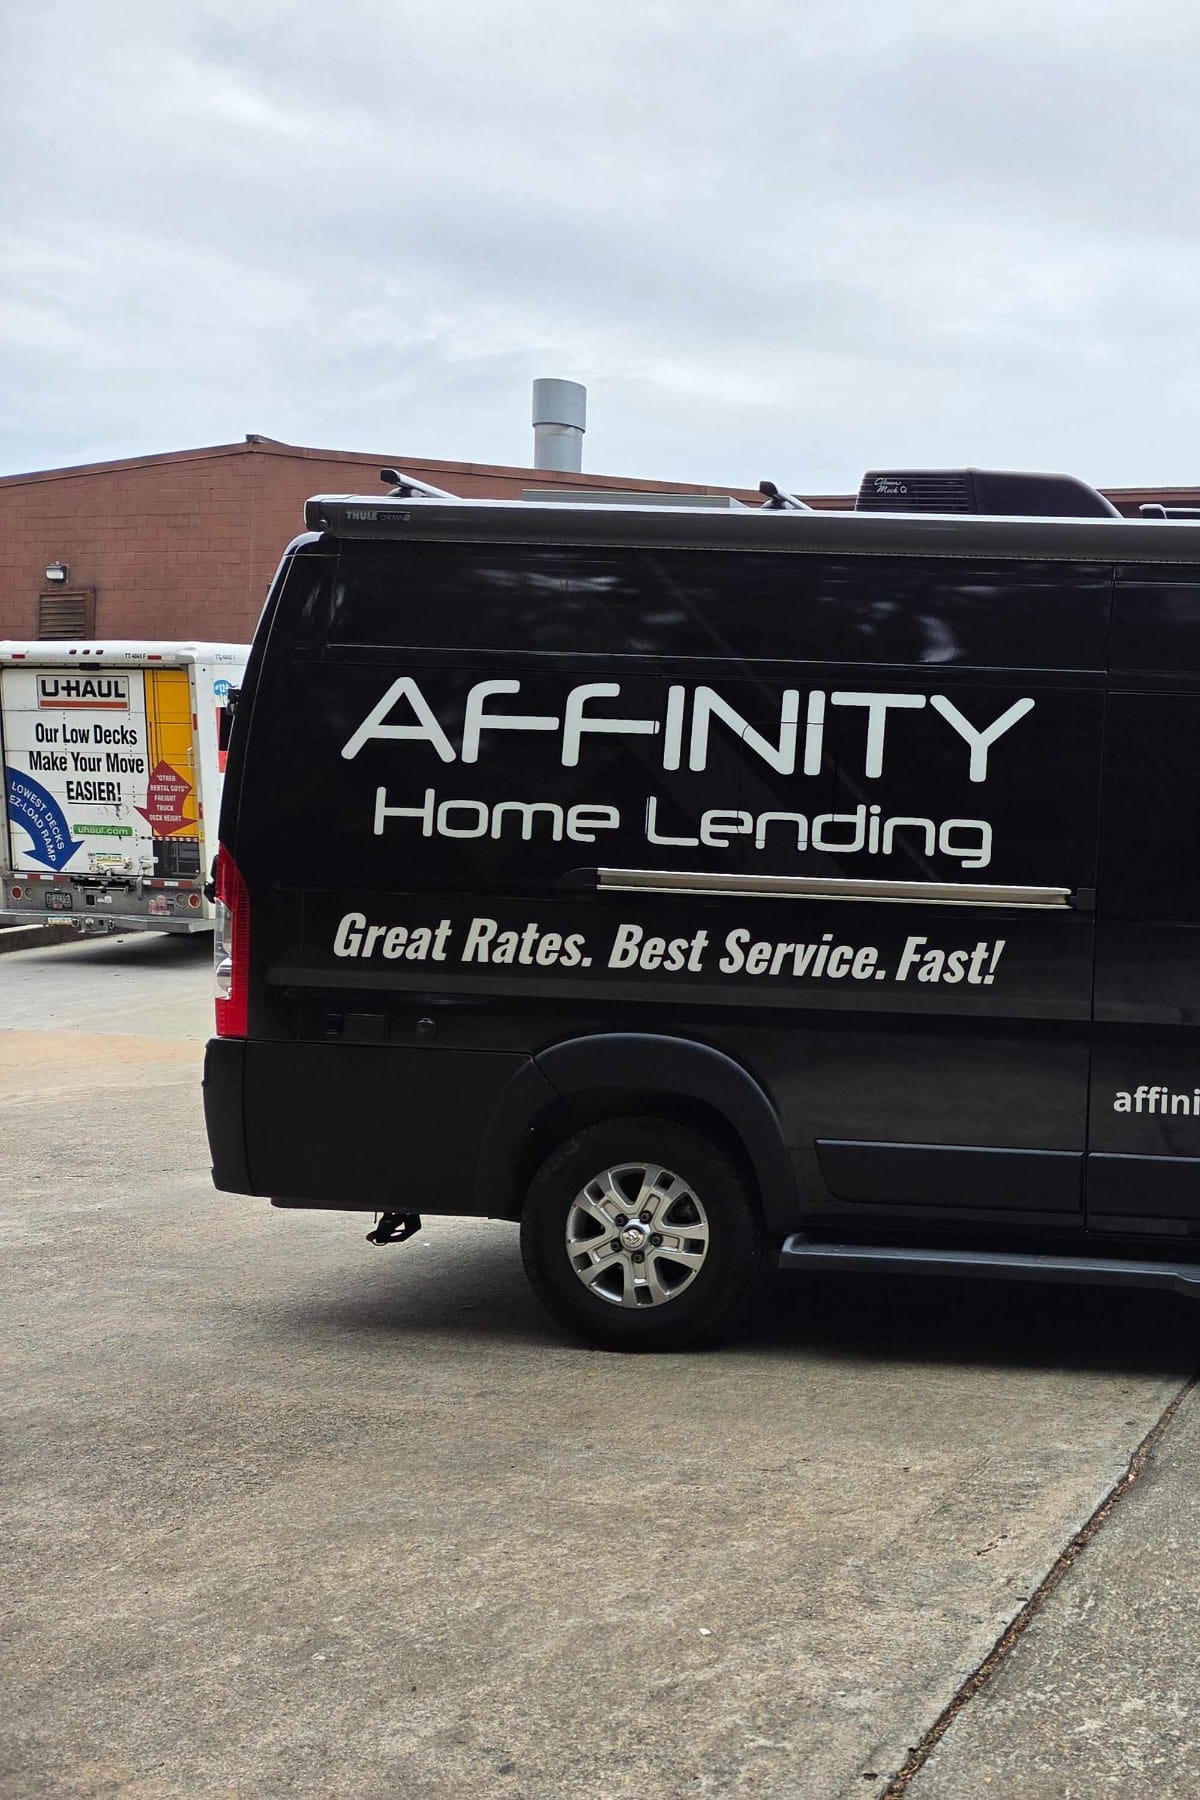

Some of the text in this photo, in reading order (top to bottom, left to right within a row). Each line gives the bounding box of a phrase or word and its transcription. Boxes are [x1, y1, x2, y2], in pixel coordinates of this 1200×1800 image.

[345, 509, 378, 521] THULE
[41, 680, 126, 698] U-HAUL
[36, 723, 138, 745] Our Low Decks
[29, 751, 145, 774] Make Your Move
[66, 781, 122, 802] EASIER!
[11, 781, 65, 849] LOWEST DECKS
[9, 794, 57, 862] EZ-LOAD RAMP
[77, 825, 128, 835] uhaul.com
[374, 787, 992, 868] Home Lending
[334, 913, 1006, 984] Great Rates. Best Service. Fast!
